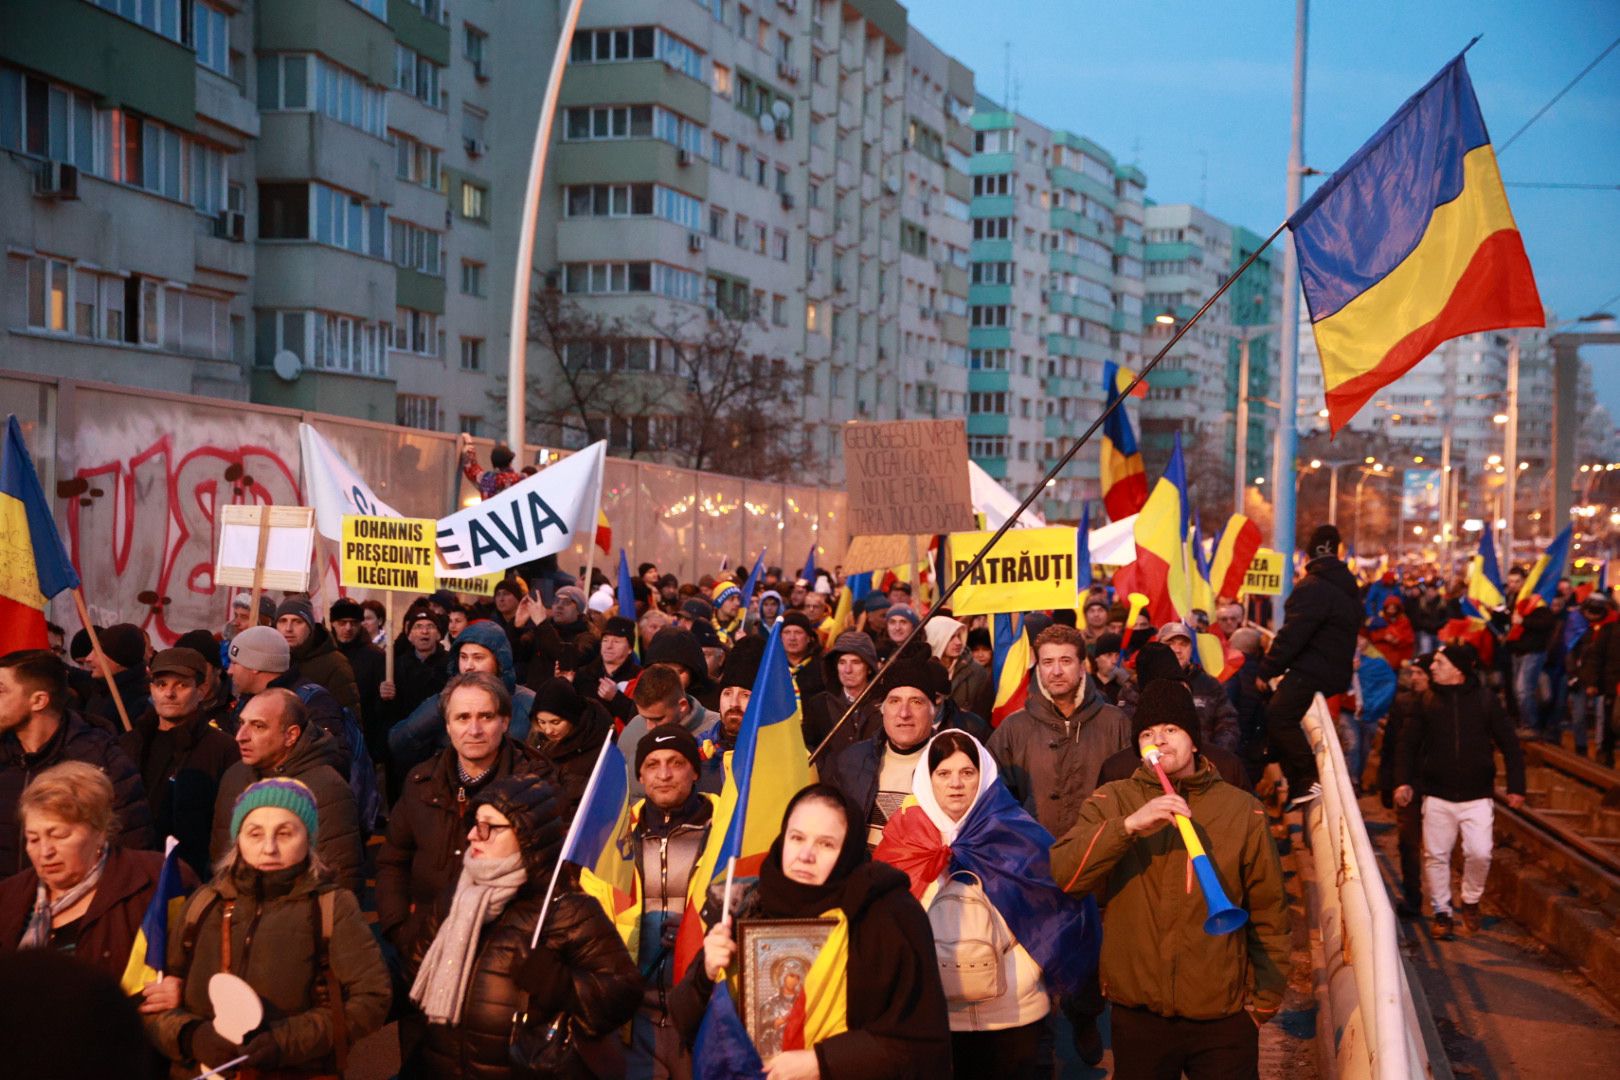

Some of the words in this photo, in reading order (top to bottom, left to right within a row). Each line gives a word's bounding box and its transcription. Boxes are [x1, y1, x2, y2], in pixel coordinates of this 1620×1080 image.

[861, 479, 879, 506] NU
[881, 478, 900, 505] NE
[920, 504, 933, 530] O
[354, 519, 423, 542] IOHANNIS
[1249, 558, 1269, 571] EA
[357, 566, 419, 588] ILEGITIM
[439, 577, 489, 593] VALORI
